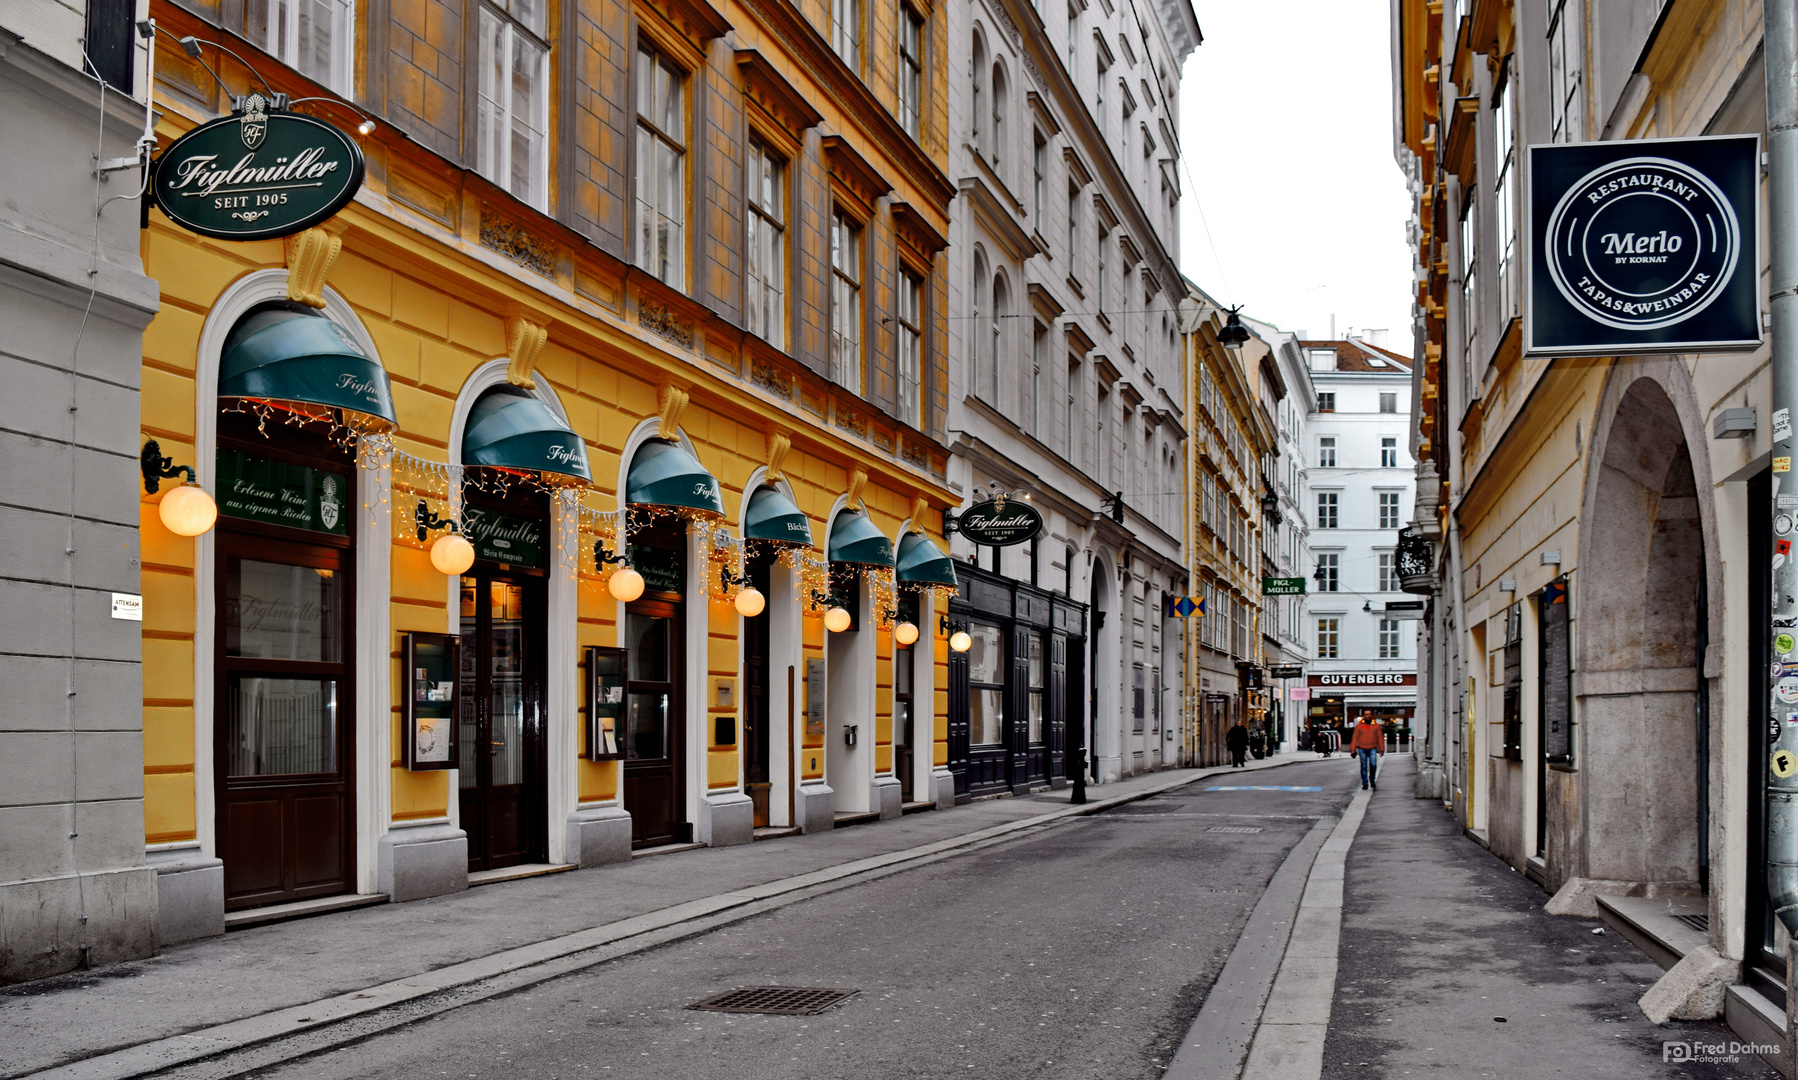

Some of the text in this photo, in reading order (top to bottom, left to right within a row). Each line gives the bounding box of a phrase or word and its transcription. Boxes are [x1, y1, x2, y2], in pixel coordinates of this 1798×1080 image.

[169, 147, 339, 197] Figlmüller
[1587, 174, 1699, 204] RESTAURANT
[214, 193, 288, 209] SEIT 1905
[1600, 230, 1683, 255] Merlo
[1615, 256, 1668, 264] BY KORNAT
[1577, 271, 1711, 316] TAPAS&WEINBAR
[233, 479, 308, 506] Erlesene Weine
[226, 500, 312, 521] aus eigenen Rieden
[964, 514, 1035, 530] Figlmüller
[467, 508, 539, 544] Figlmüller
[1321, 674, 1404, 685] GUTENBERG
[1776, 755, 1789, 773] F
